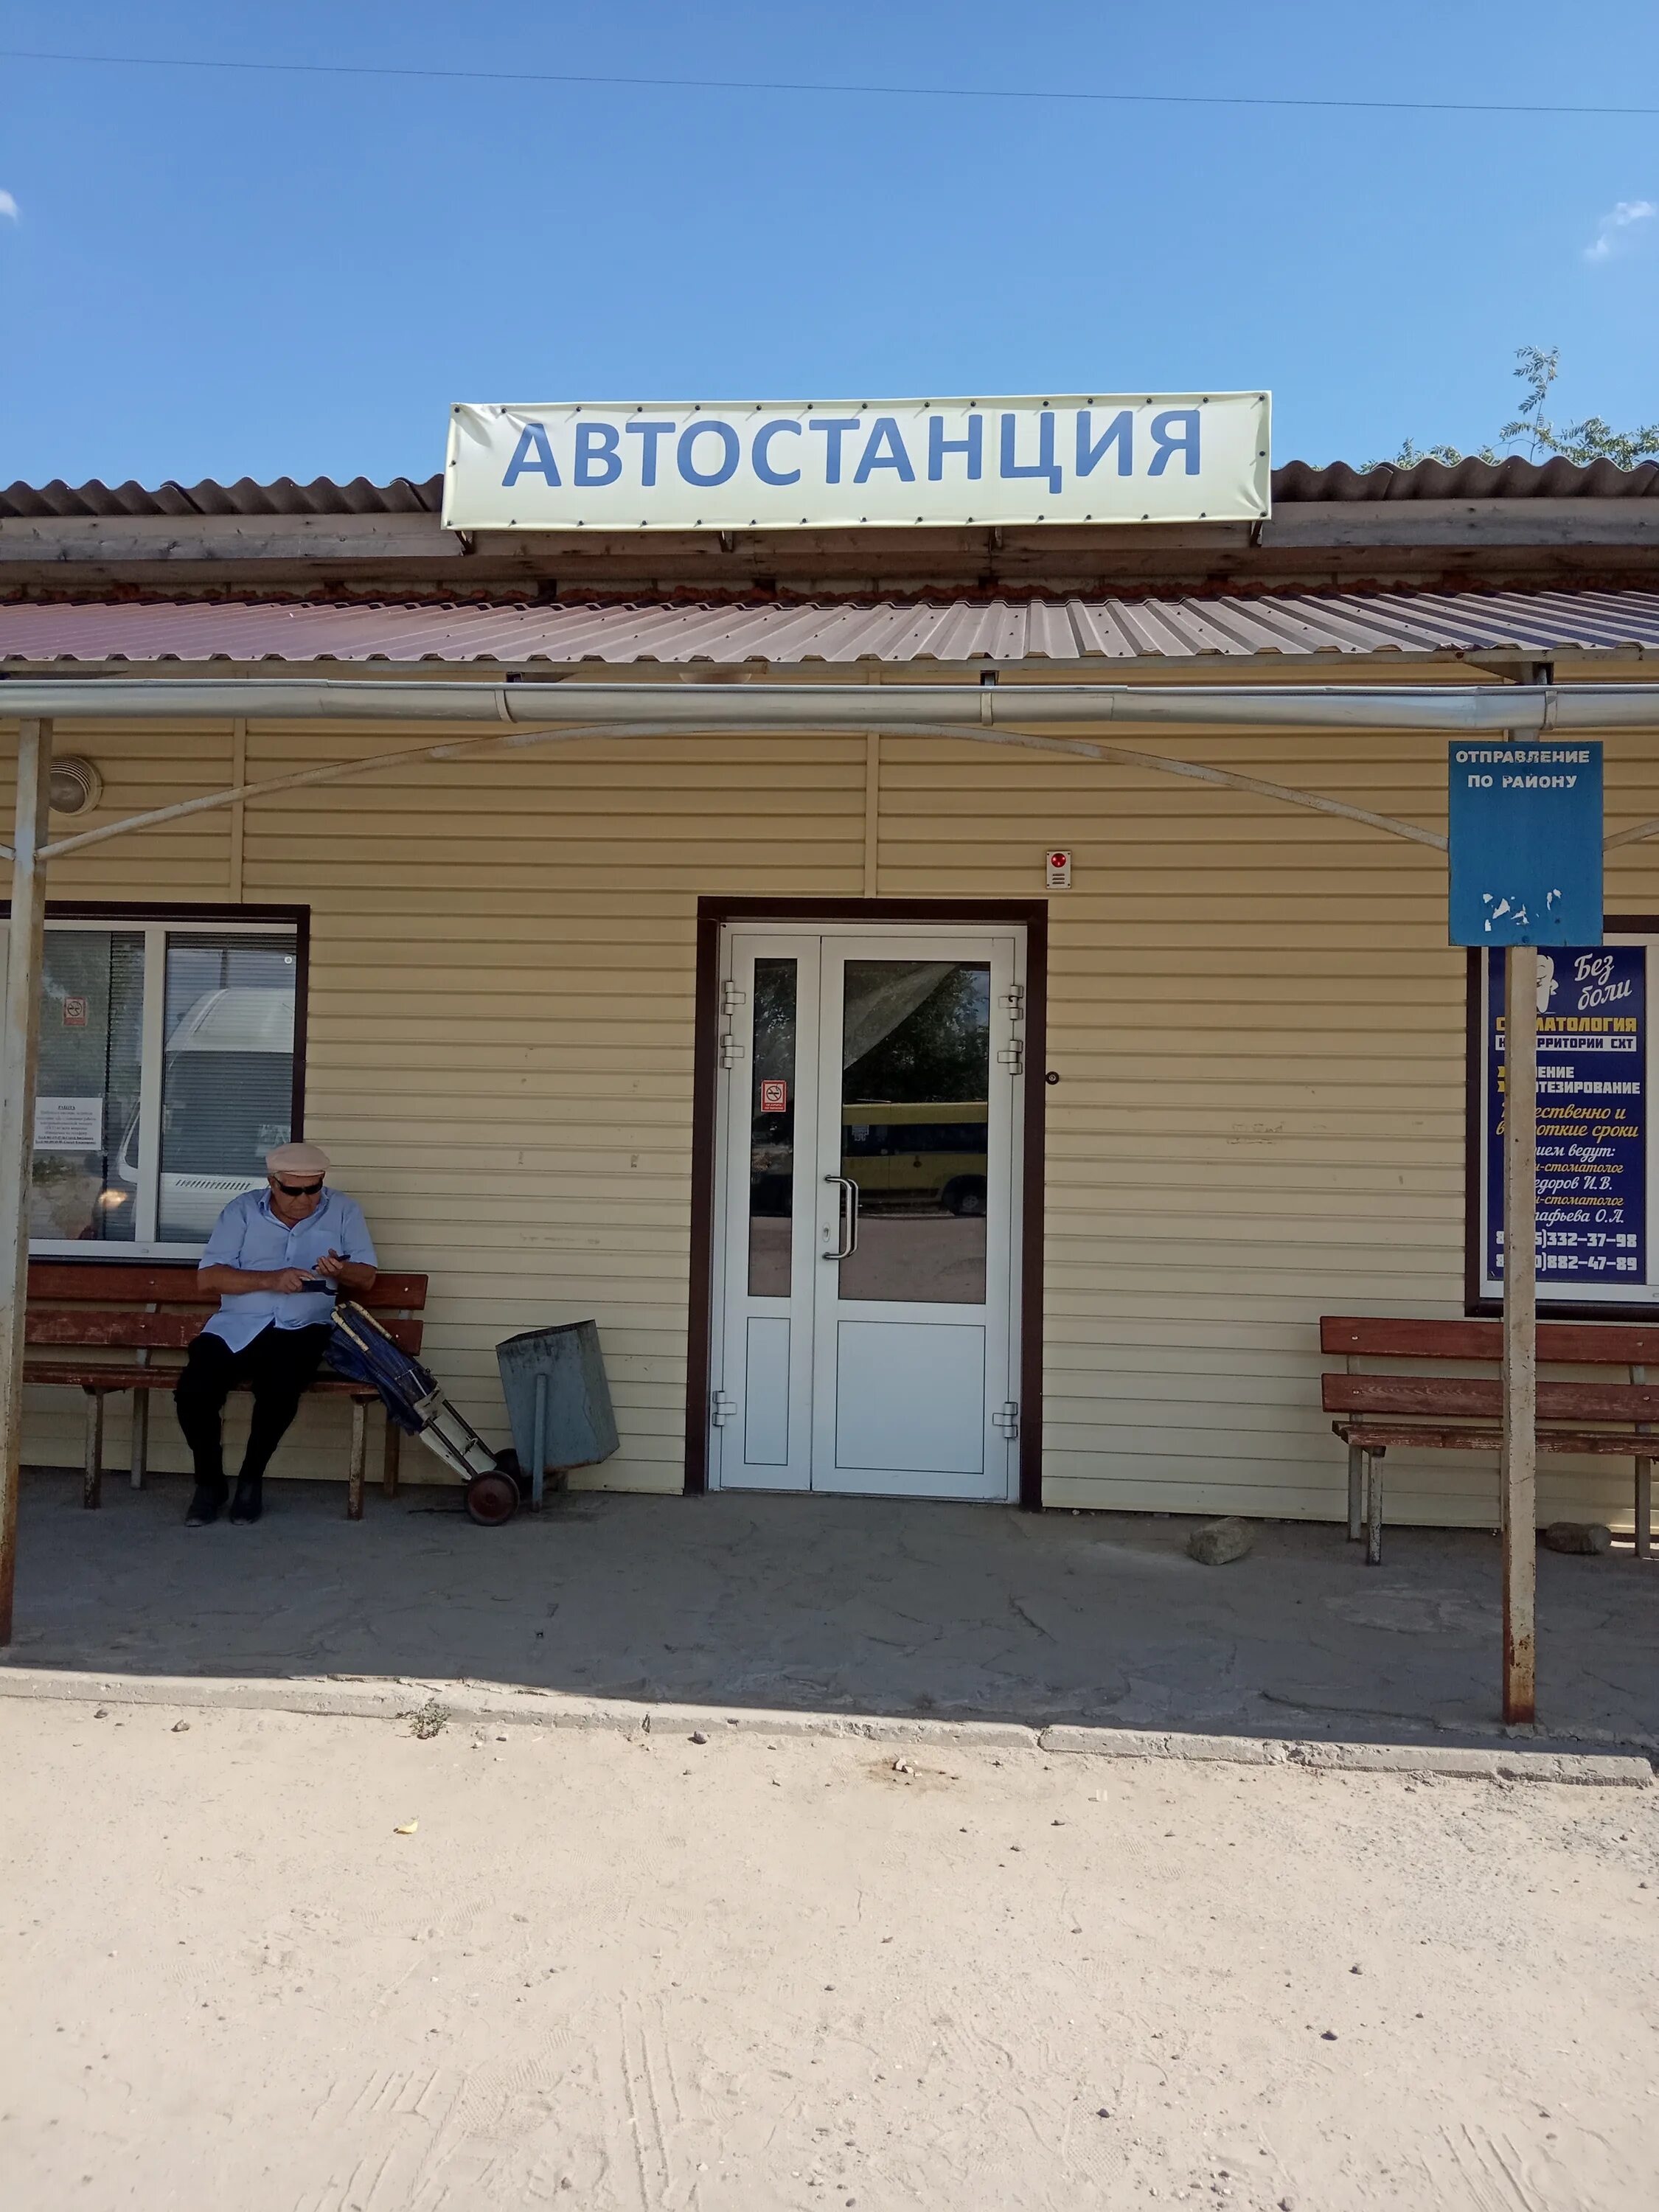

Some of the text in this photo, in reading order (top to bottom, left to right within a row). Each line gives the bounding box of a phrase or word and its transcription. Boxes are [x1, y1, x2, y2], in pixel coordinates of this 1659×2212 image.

[501, 410, 1201, 494] АВТОСТАНЦИЯ
[1455, 750, 1590, 763] ОТПРАВЛЕНИЕ
[1467, 773, 1577, 788] ПО РАЙОНУ
[1574, 953, 1615, 985] Без
[1577, 980, 1632, 1010] боли
[1496, 1017, 1637, 1032] СМАТОЛОГИЯ
[1537, 1038, 1603, 1048] РРИТОРИИ
[1611, 1039, 1633, 1048] СХТ
[1536, 1066, 1574, 1078] ЕНИЕ
[1536, 1080, 1641, 1094] ТЕЗИРОВАНИЕ
[1615, 1108, 1626, 1119] и
[1536, 1125, 1588, 1136] откие
[1593, 1126, 1638, 1144] сроки
[1535, 1144, 1615, 1162] ием ведут:
[1535, 1177, 1579, 1194] едоров
[1596, 1208, 1624, 1223] О.А.
